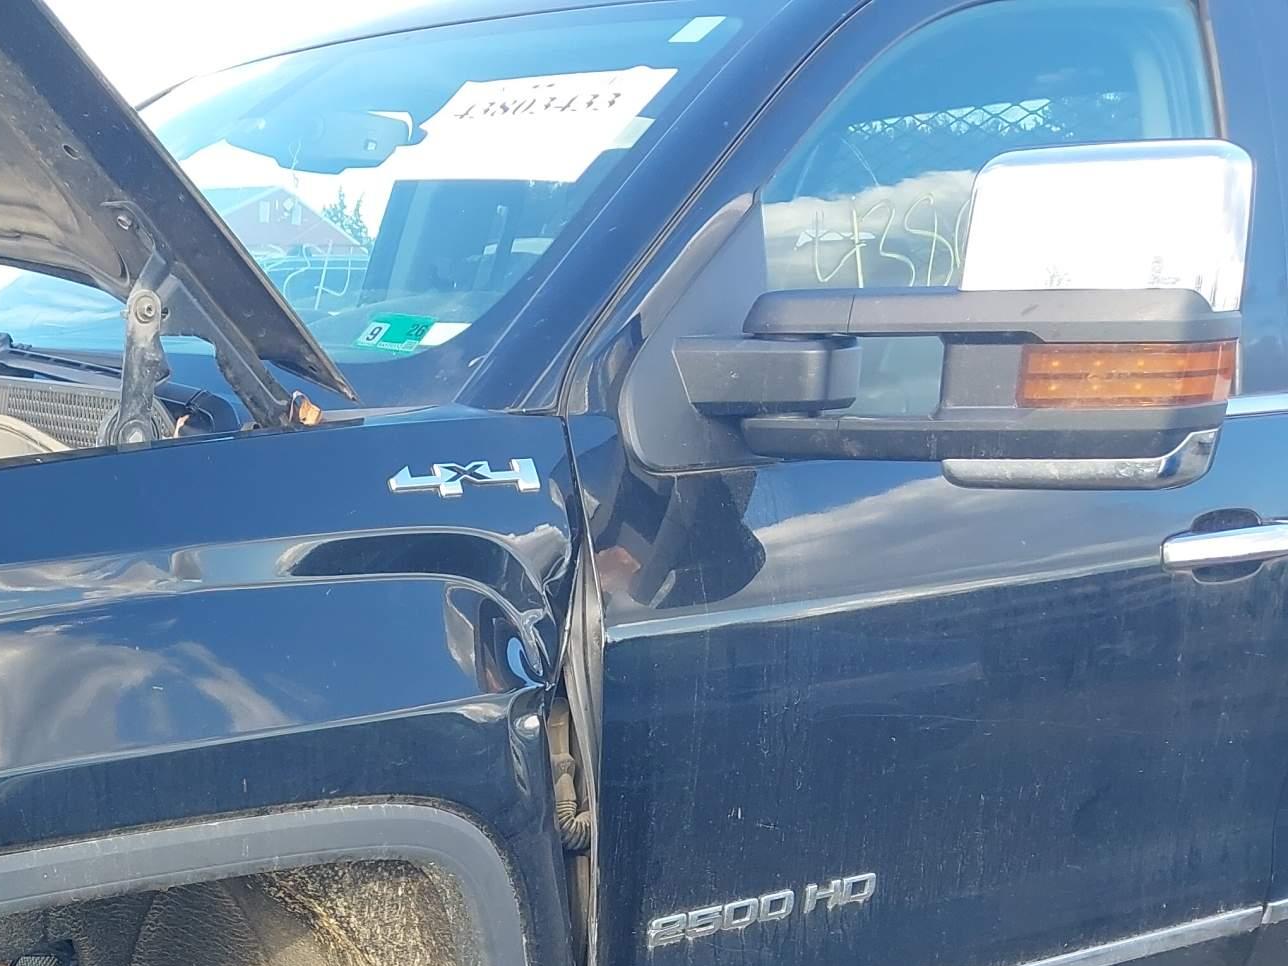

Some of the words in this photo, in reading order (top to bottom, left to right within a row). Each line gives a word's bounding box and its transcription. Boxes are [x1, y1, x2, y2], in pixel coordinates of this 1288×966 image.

[365, 326, 383, 342] 9
[406, 323, 429, 338] 26
[648, 888, 795, 951] 2500
[803, 872, 877, 913] HD
